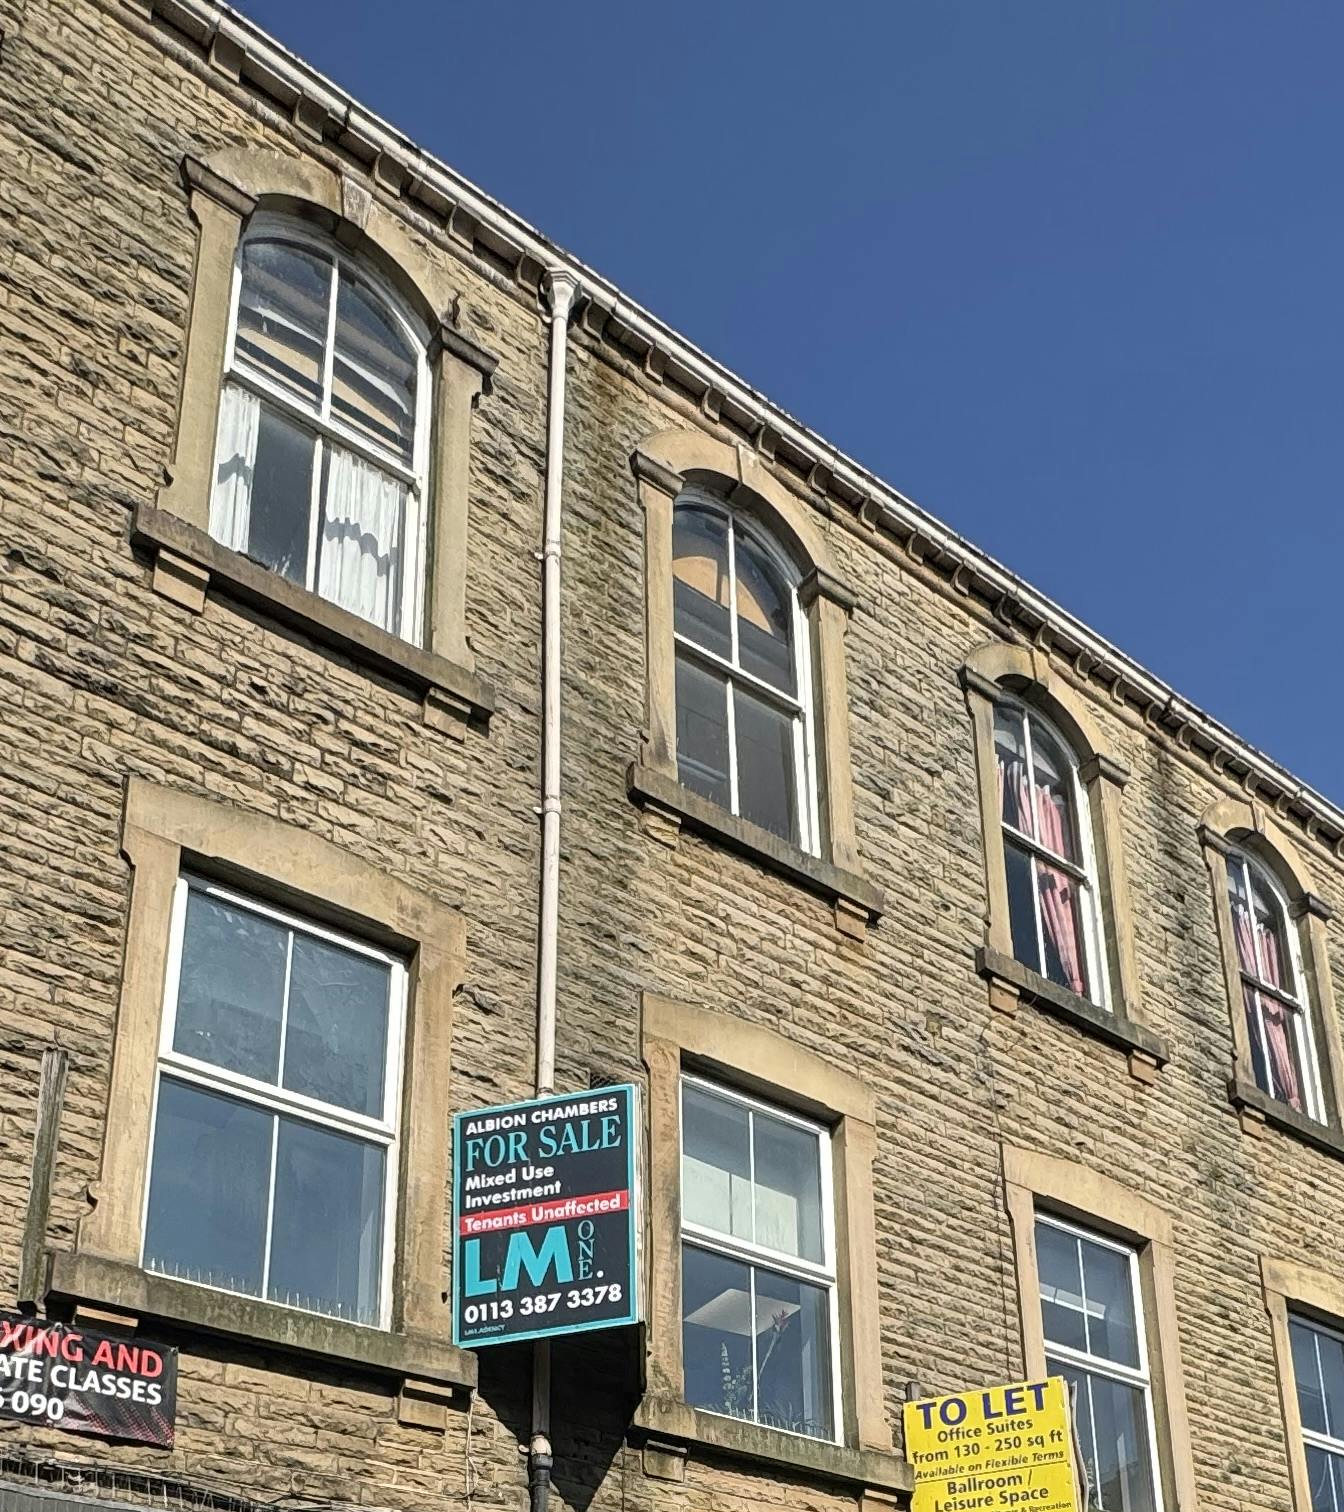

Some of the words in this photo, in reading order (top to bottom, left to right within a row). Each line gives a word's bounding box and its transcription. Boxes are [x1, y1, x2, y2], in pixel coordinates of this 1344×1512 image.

[465, 1114, 527, 1135] ALBION
[531, 1098, 618, 1124] CHAMBERS
[465, 1132, 528, 1172] FOR
[538, 1115, 621, 1159] SALE
[465, 1169, 517, 1191] Mixed
[522, 1165, 554, 1181] Use
[465, 1181, 562, 1209] Investment
[465, 1210, 526, 1232] Tenants
[532, 1195, 621, 1222] Unaffected
[464, 1226, 573, 1298] LM
[464, 1299, 514, 1323] 0113
[519, 1293, 561, 1316] 387
[567, 1284, 623, 1309] 3378
[91, 1340, 163, 1379] AND
[49, 1364, 163, 1405] CLASSES
[11, 1391, 65, 1421] 090
[916, 1397, 968, 1430] TO
[982, 1382, 1049, 1420] LET
[912, 1449, 948, 1465] from
[954, 1442, 980, 1458] 130
[995, 1438, 1022, 1453] 250
[1027, 1436, 1045, 1449] sq
[1050, 1428, 1063, 1444] ft
[937, 1427, 982, 1443] Office
[987, 1418, 1034, 1436] Suites
[915, 1463, 966, 1480] Available
[968, 1463, 982, 1472] on
[985, 1454, 1029, 1469] Flexible
[1032, 1449, 1065, 1462] Terms
[947, 1474, 1024, 1495] Ballroom
[999, 1487, 1049, 1507] Space
